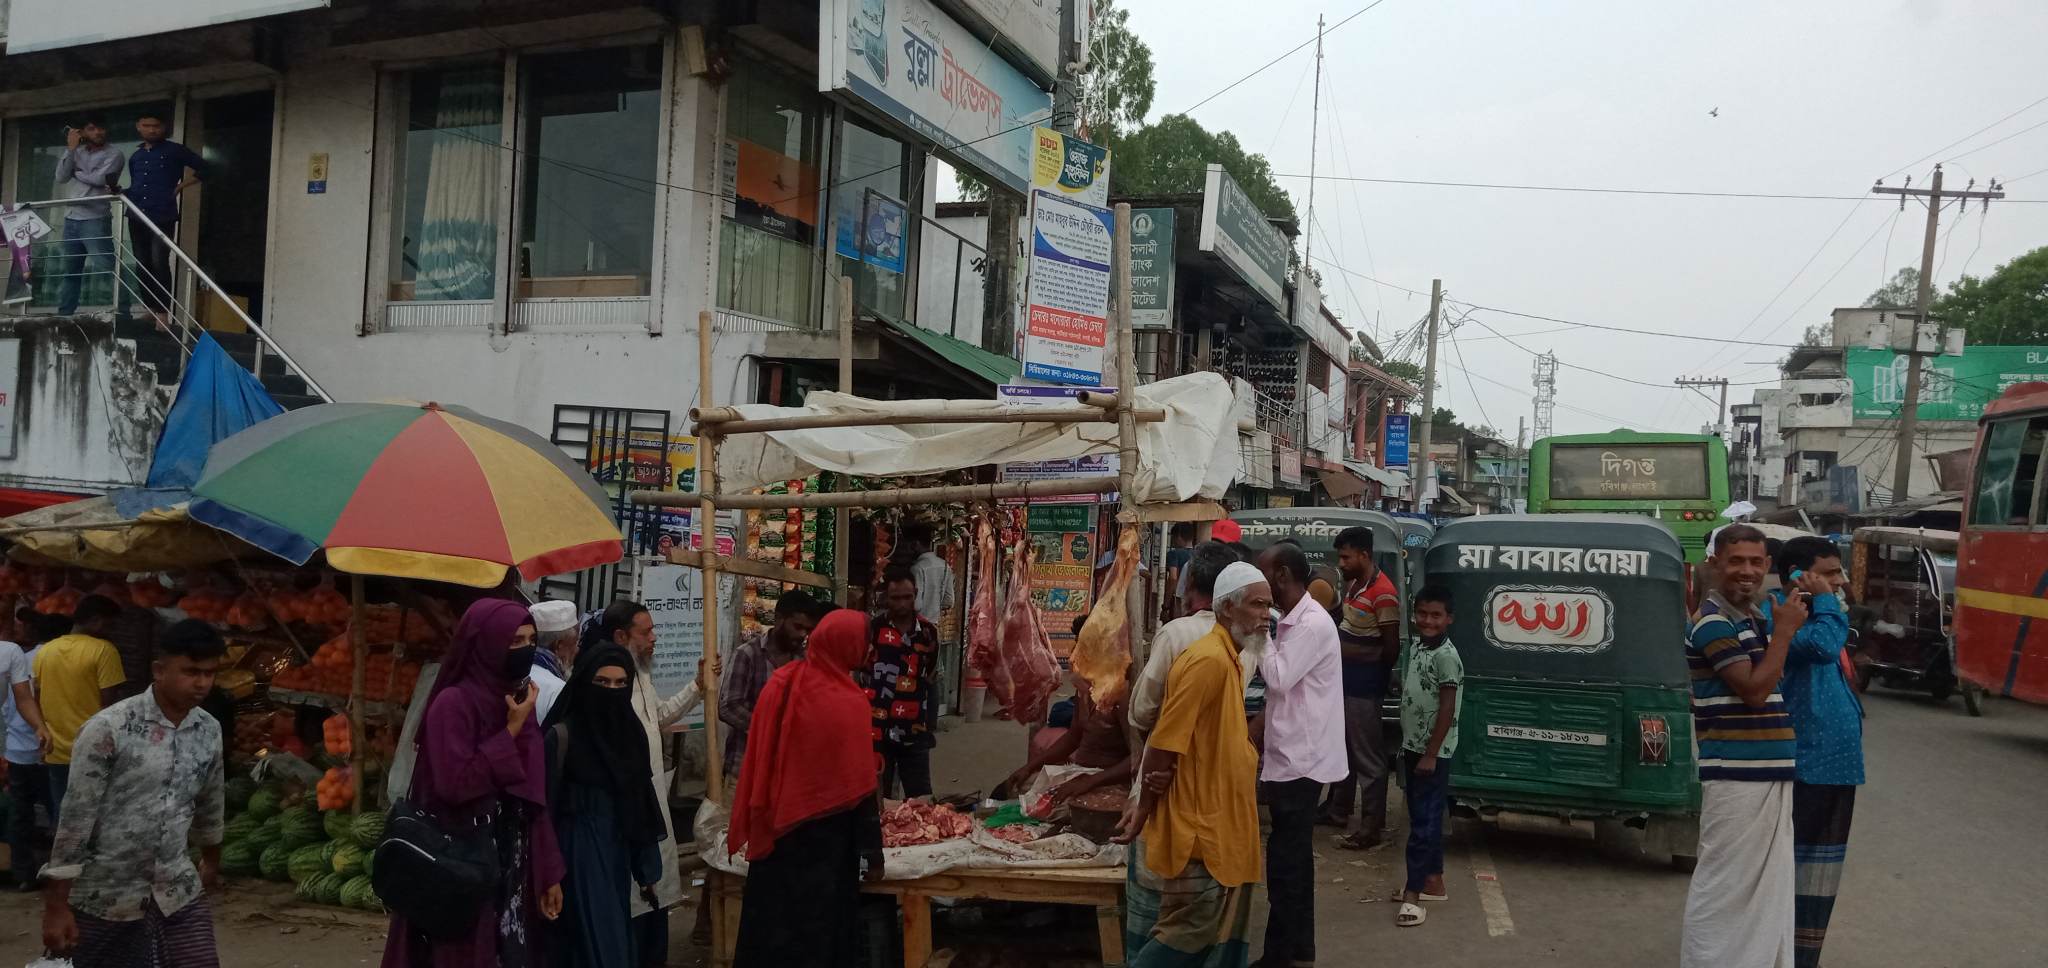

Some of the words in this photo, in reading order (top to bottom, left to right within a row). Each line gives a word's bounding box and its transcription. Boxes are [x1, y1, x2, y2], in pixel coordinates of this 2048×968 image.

[902, 26, 938, 92] বুল্লা
[940, 41, 1002, 130] ট্রাভেলস
[1131, 240, 1158, 256] সলামী
[1601, 451, 1657, 476] দিগন্ত
[1458, 545, 1494, 569] মা
[1499, 546, 1584, 573] বাবার
[1584, 549, 1650, 576] দোয়া
